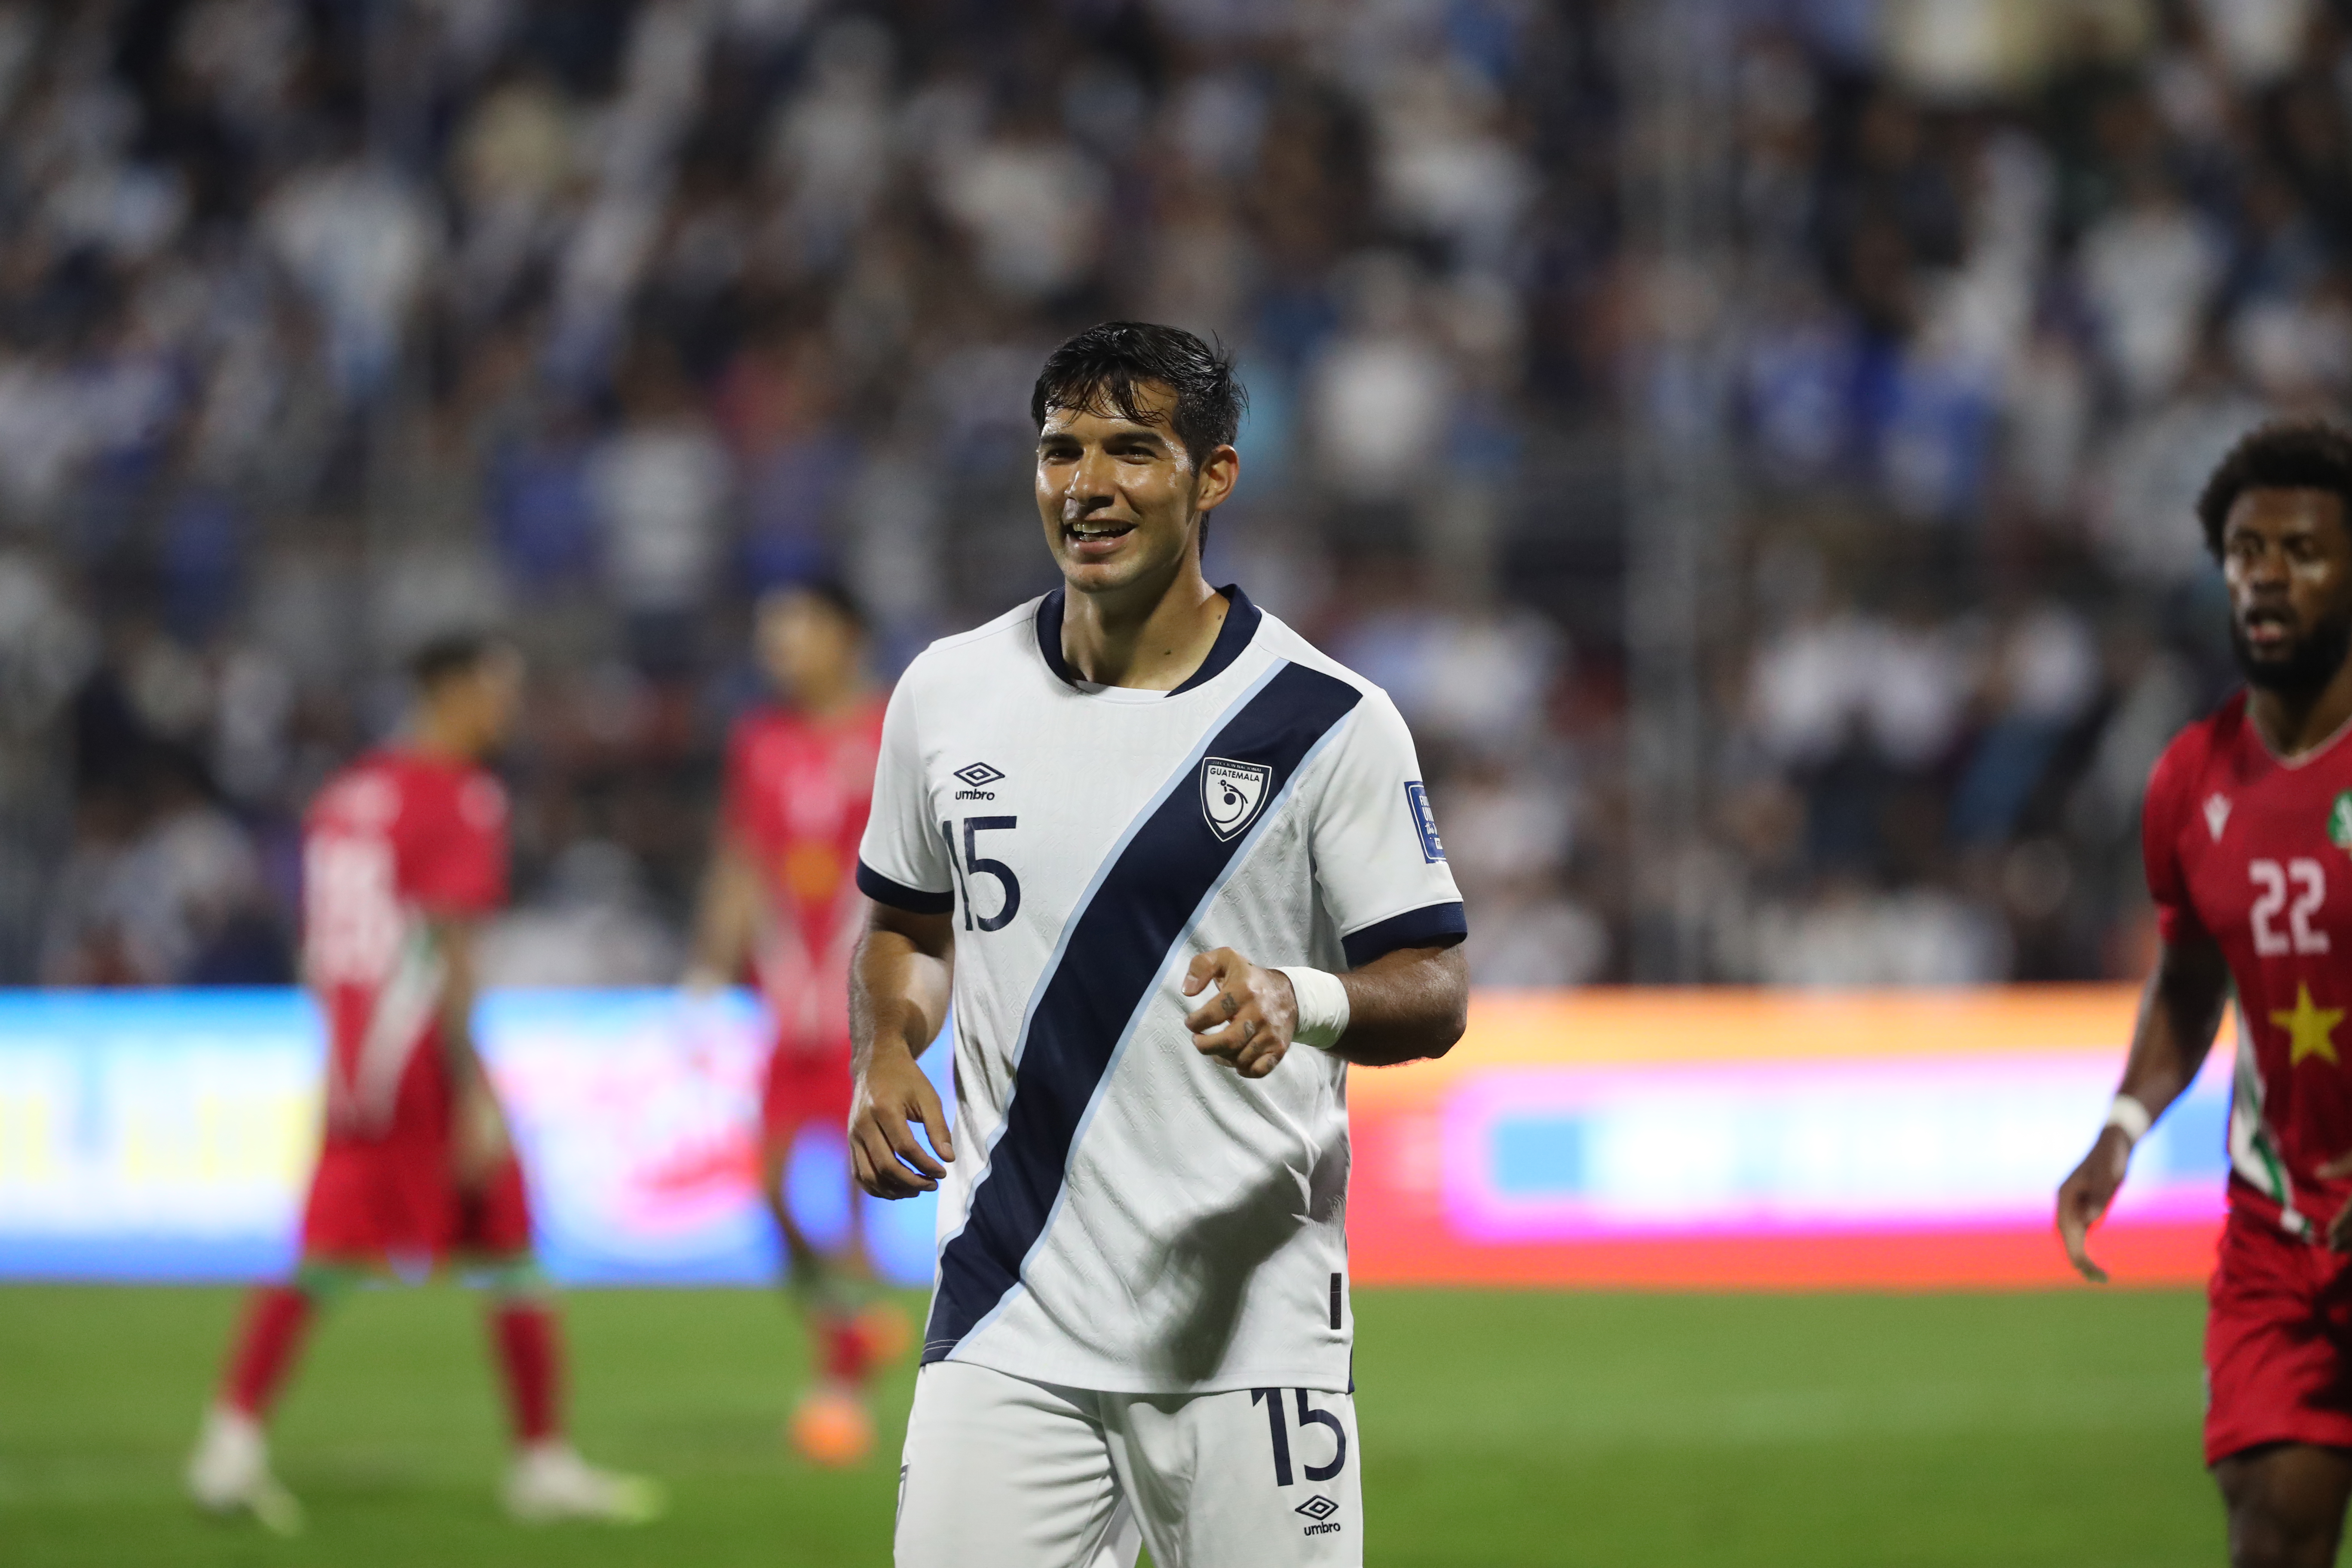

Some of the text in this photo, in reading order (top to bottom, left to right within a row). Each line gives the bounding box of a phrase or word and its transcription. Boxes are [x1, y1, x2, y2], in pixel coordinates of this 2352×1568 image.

[956, 788, 995, 800] umbro
[1210, 768, 1259, 782] GUATEMALA
[942, 815, 1020, 931] 15
[2248, 858, 2331, 956] 22
[1251, 1388, 1346, 1486] 15
[1304, 1522, 1341, 1536] umbro
